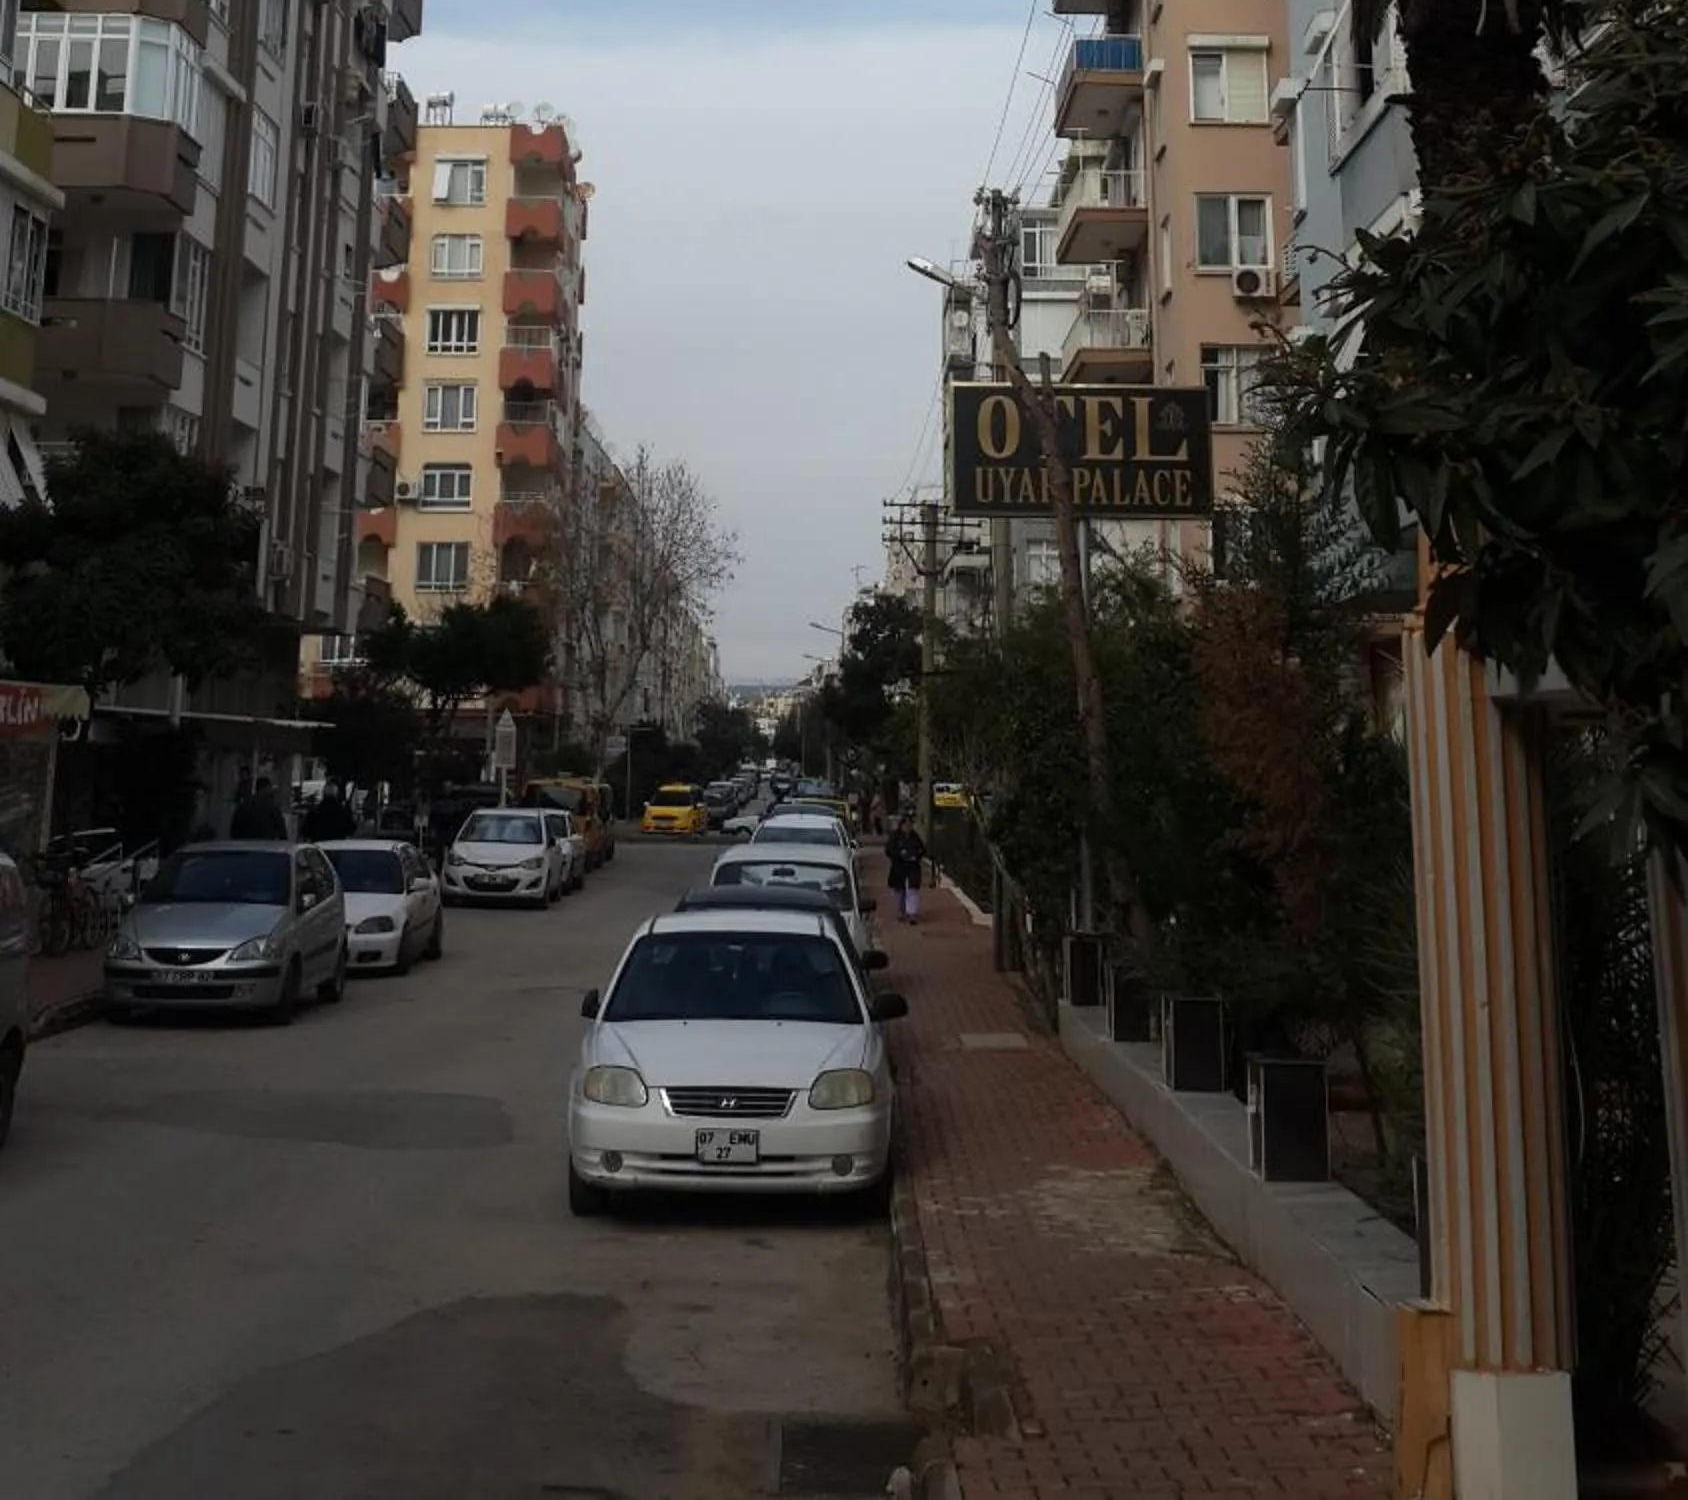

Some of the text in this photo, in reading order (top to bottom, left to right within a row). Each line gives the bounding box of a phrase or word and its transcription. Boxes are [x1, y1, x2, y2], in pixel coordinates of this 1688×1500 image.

[1072, 467, 1191, 506] PALACE
[700, 1131, 714, 1144] 07
[716, 1146, 731, 1159] 27
